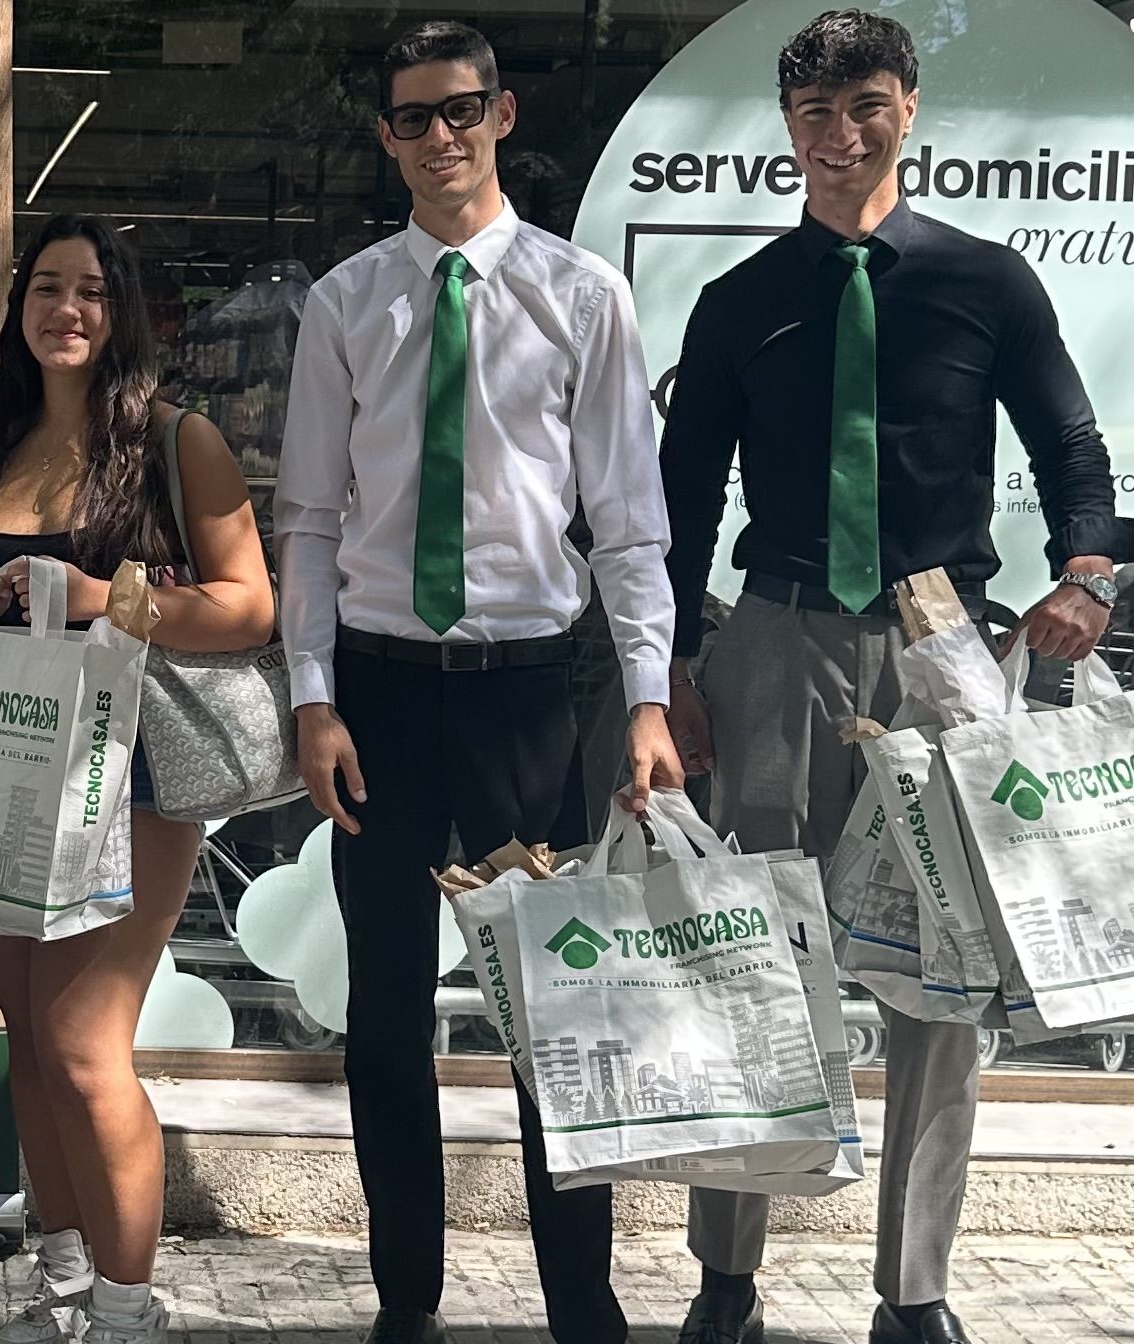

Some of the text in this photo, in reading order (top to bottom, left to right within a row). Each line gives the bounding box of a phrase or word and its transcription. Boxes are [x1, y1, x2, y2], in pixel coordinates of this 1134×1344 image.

[629, 152, 803, 195] serve
[83, 690, 112, 827] TECNOCASA.ES
[1104, 796, 1134, 809] FRANC
[897, 772, 950, 911] TECNOCASA.ES
[1063, 817, 1134, 837] INMOBILIARI
[613, 907, 769, 958] TECNOCASA
[478, 924, 522, 1060] TECNOCASA.ES
[599, 978, 613, 987] LA
[618, 977, 701, 989] INMOBILIARIA
[706, 972, 726, 984] DEL
[730, 960, 773, 977] BARRIO
